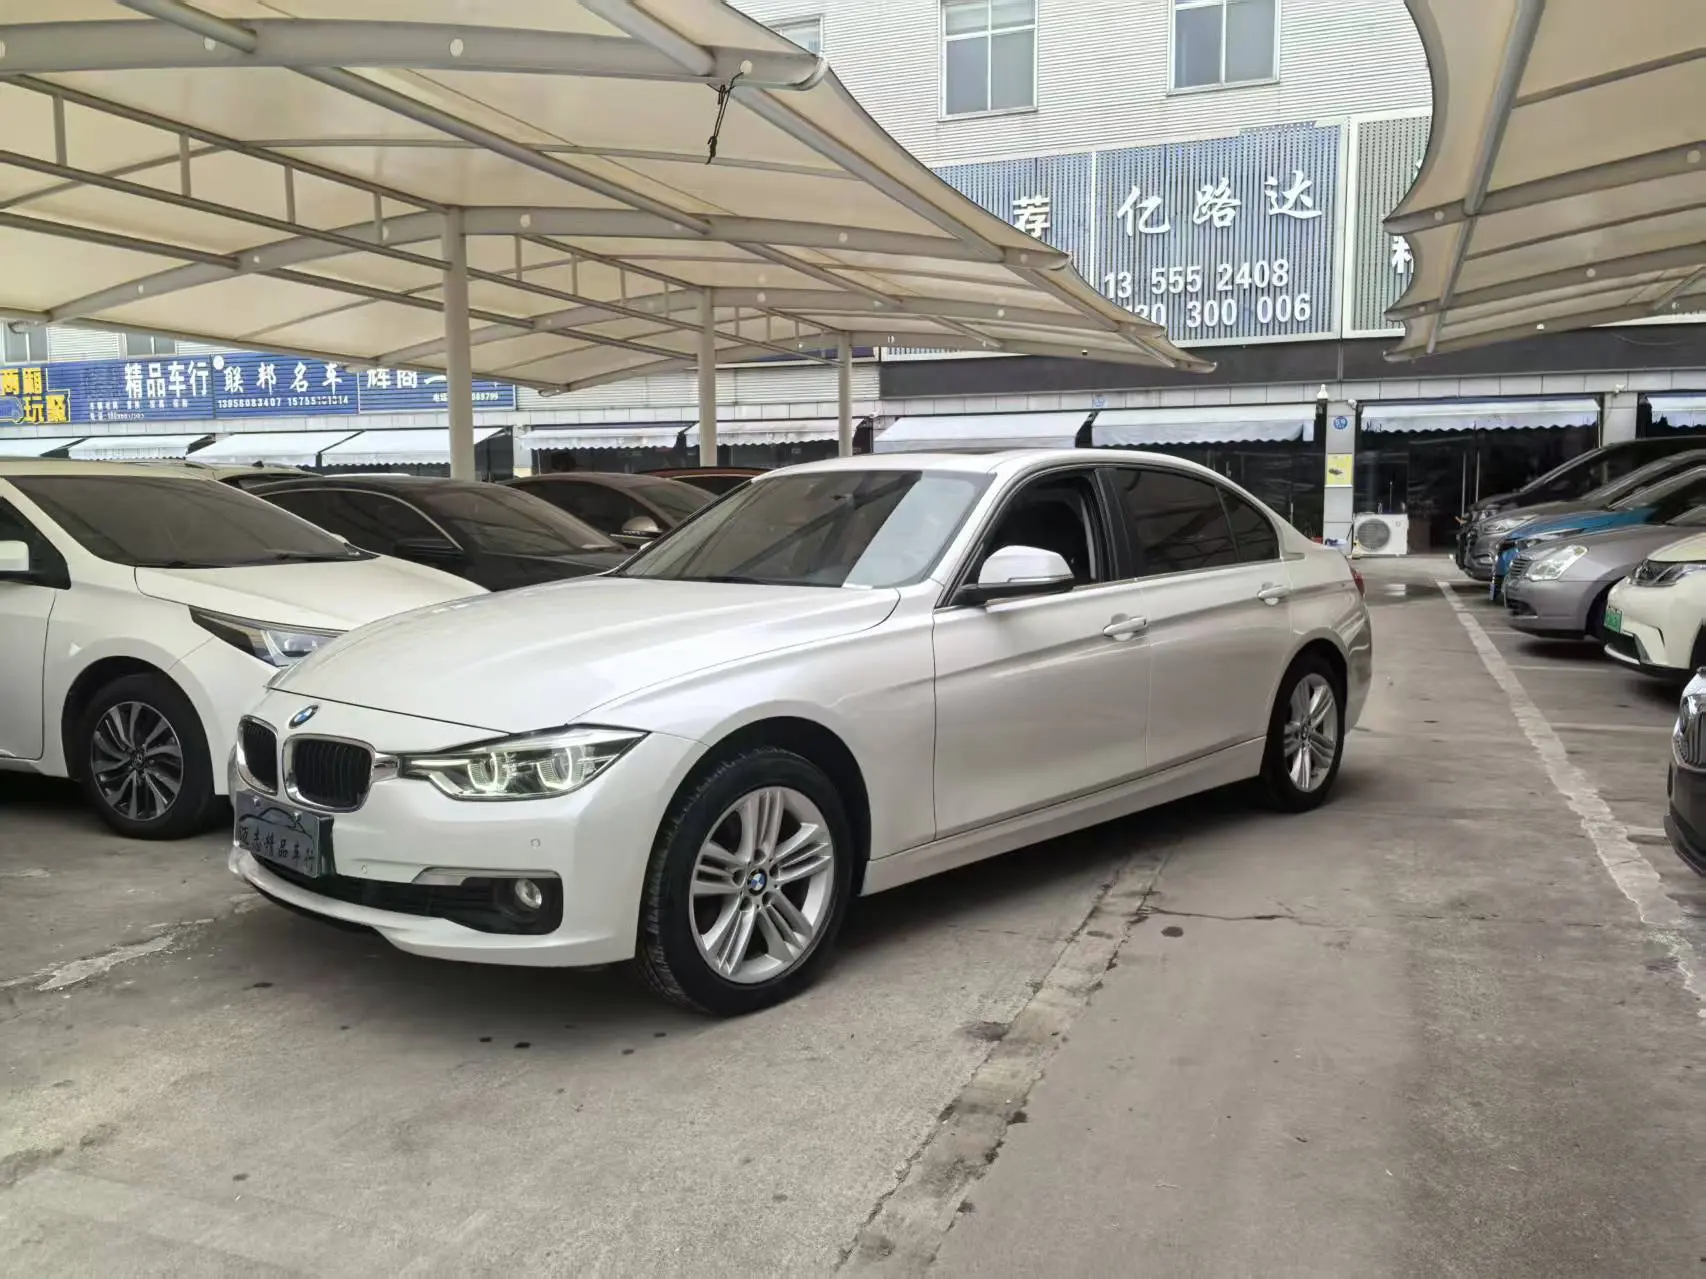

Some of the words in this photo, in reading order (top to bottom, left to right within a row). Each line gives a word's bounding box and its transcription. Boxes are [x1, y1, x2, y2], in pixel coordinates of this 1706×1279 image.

[1116, 170, 1323, 237] 亿路达
[1151, 265, 1202, 295] 555
[1217, 259, 1289, 291] 2408
[1186, 298, 1238, 328] 300
[1257, 293, 1311, 323] 006
[124, 359, 209, 399] 精品车行
[223, 361, 344, 396] 联邦名车
